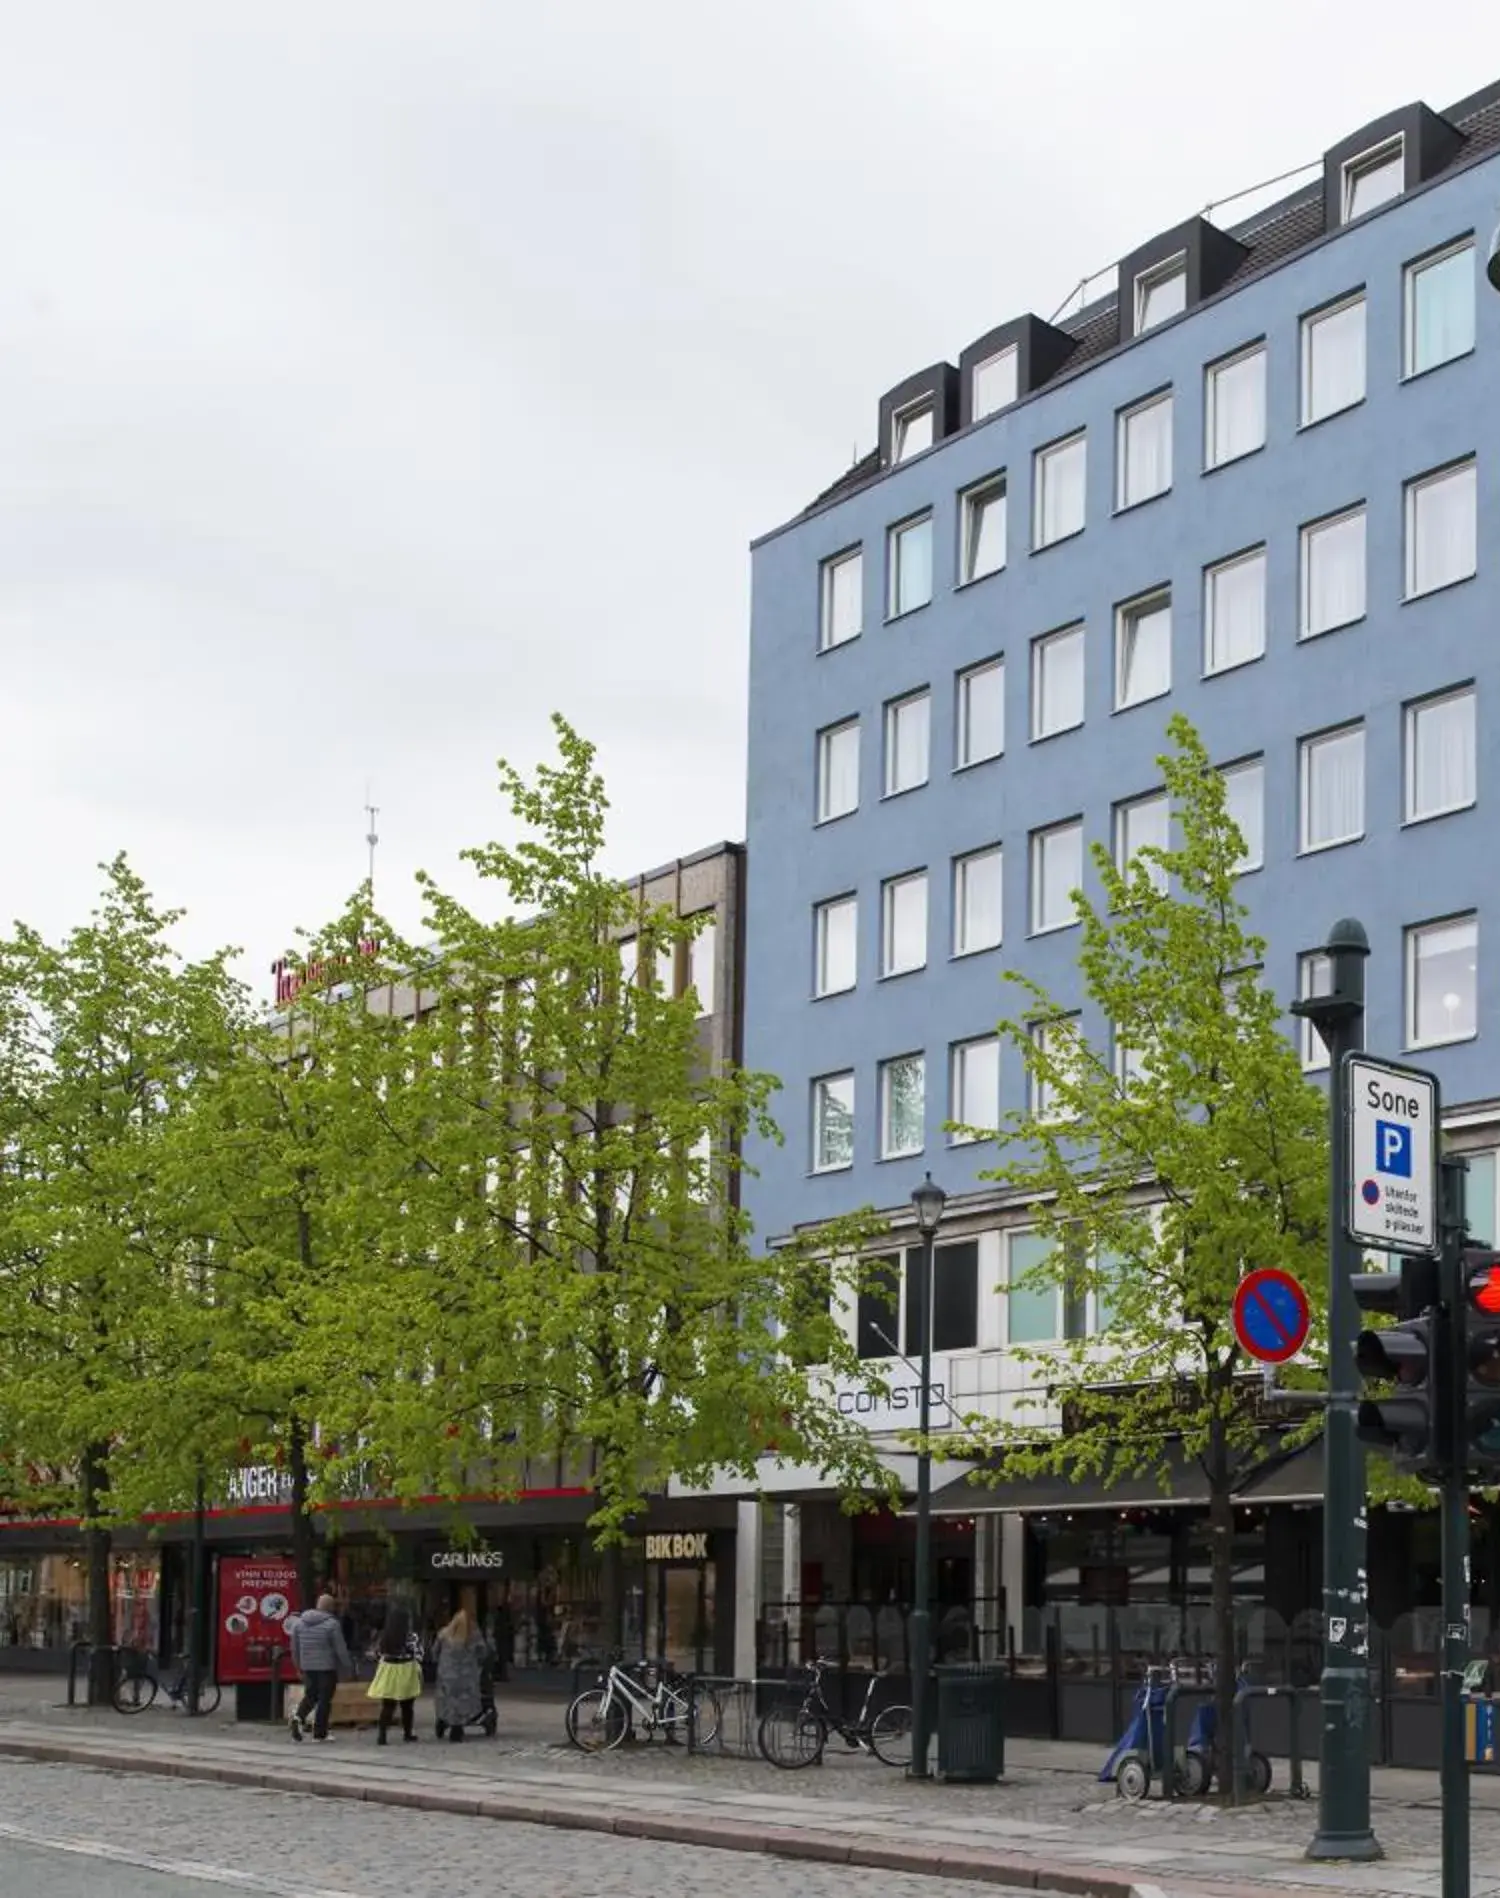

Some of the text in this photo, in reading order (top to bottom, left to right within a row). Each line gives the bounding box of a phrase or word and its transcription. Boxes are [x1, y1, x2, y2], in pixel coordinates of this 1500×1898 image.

[1367, 1081, 1419, 1119] Sone
[1383, 1128, 1403, 1168] P
[431, 1551, 504, 1568] CARLINGS
[645, 1533, 708, 1559] BIK BOK
